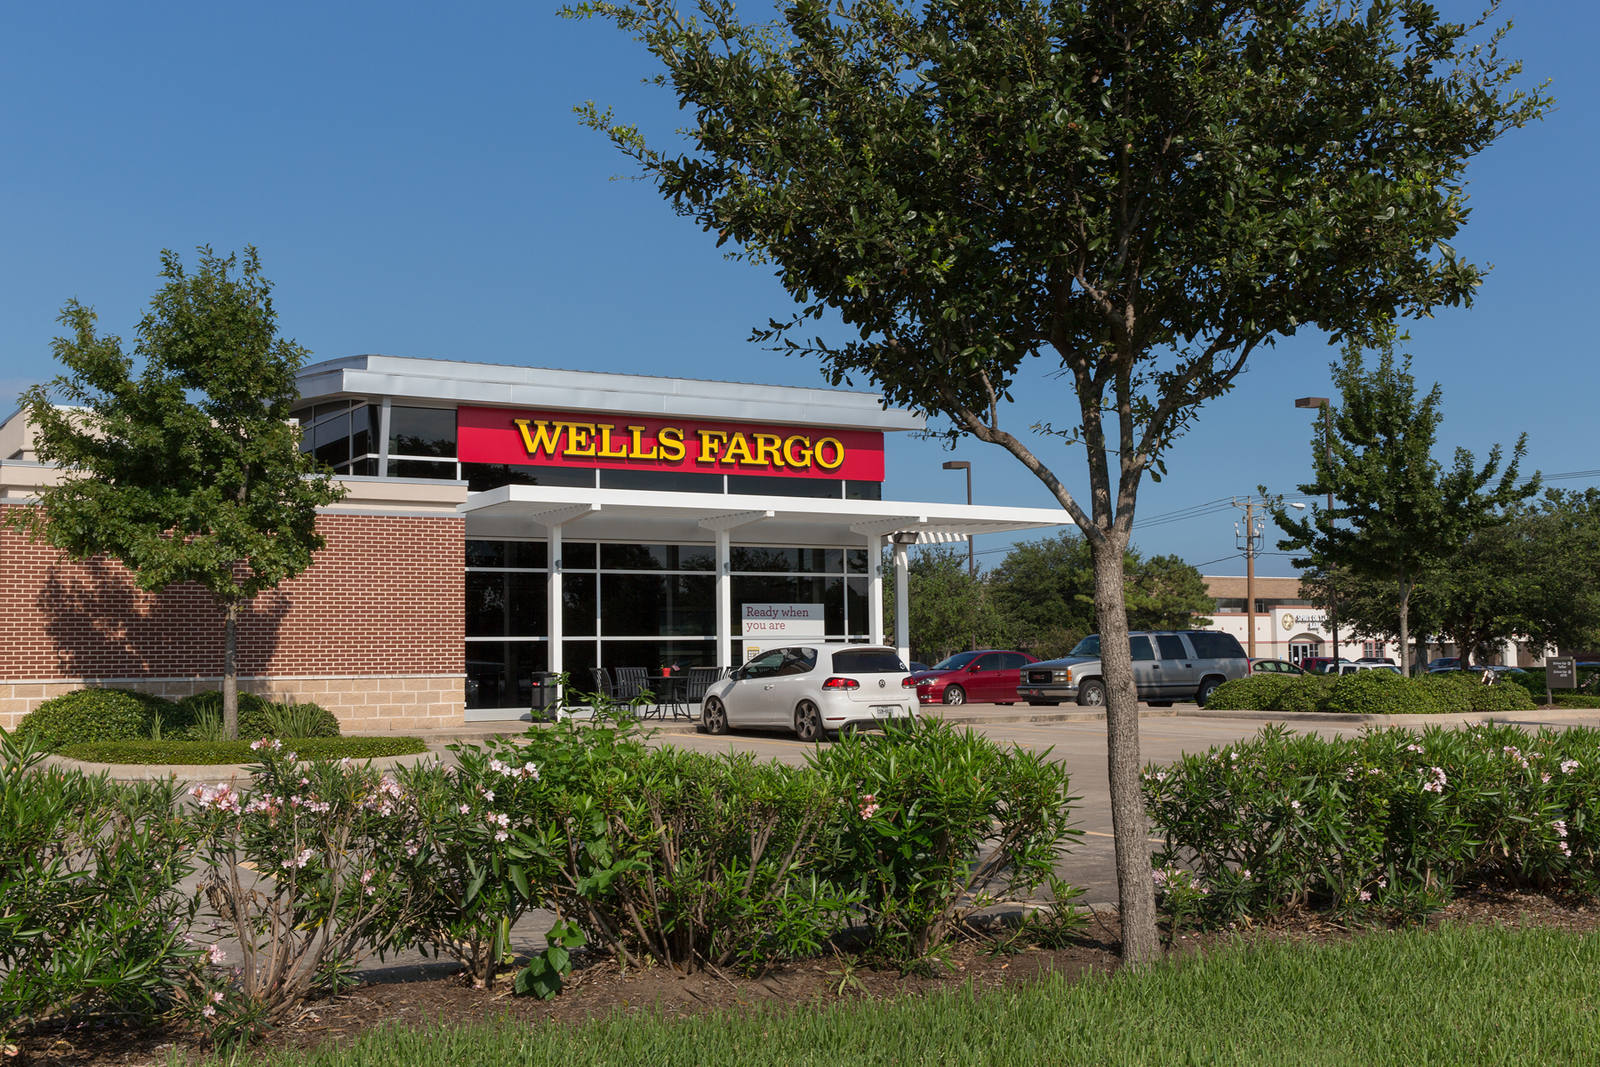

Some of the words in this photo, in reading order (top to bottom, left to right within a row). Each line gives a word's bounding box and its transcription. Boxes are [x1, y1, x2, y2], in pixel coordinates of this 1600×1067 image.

[513, 418, 686, 461] WELLS
[697, 429, 845, 469] FARGO
[746, 605, 779, 619] Ready
[781, 606, 809, 617] when
[746, 622, 766, 632] you
[769, 622, 786, 630] are
